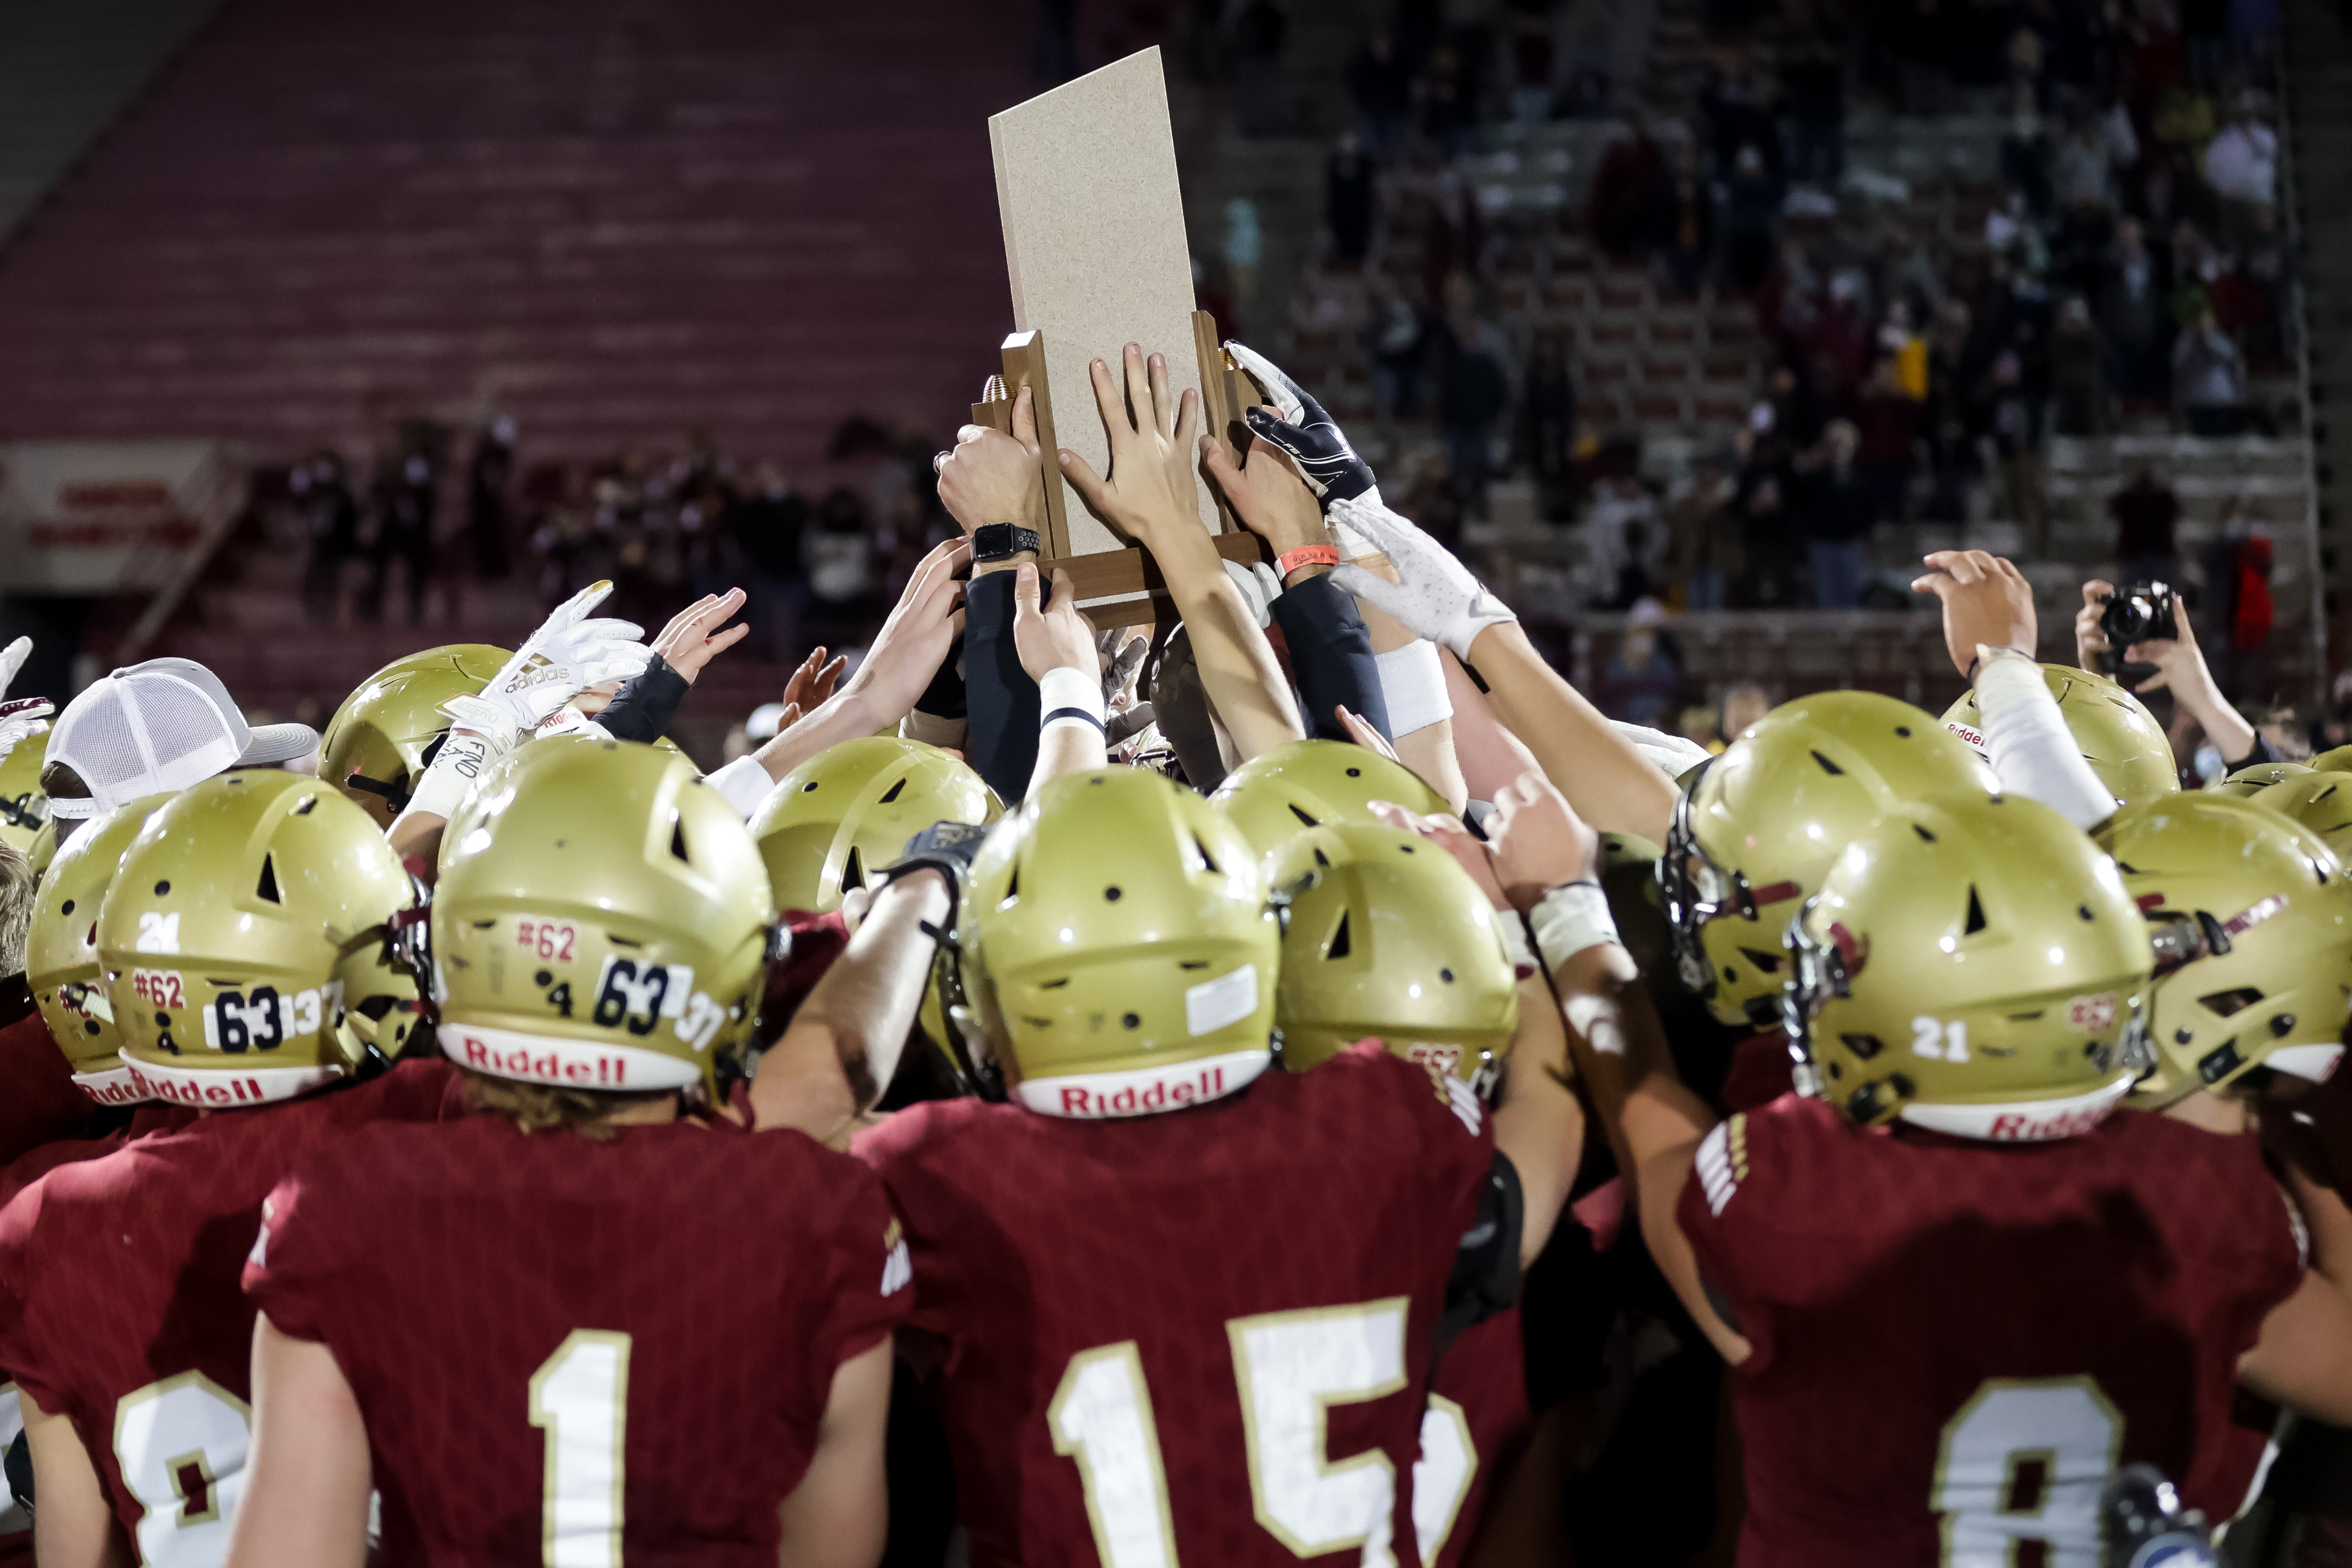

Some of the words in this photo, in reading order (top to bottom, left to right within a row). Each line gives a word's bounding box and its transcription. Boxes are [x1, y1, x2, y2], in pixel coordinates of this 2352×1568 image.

[506, 666, 570, 693] adidas
[455, 700, 499, 724] ADIZERO
[455, 740, 485, 779] FIND
[136, 910, 181, 955] 21
[517, 921, 577, 964] #62
[132, 971, 187, 1011] #62
[593, 958, 669, 1037] 63
[216, 985, 283, 1054] 63
[1911, 1014, 1971, 1064] 21
[464, 1036, 626, 1084] Riddell
[1060, 1066, 1225, 1116] Riddell
[528, 1328, 632, 1568] 1
[1047, 1295, 1410, 1568] 15
